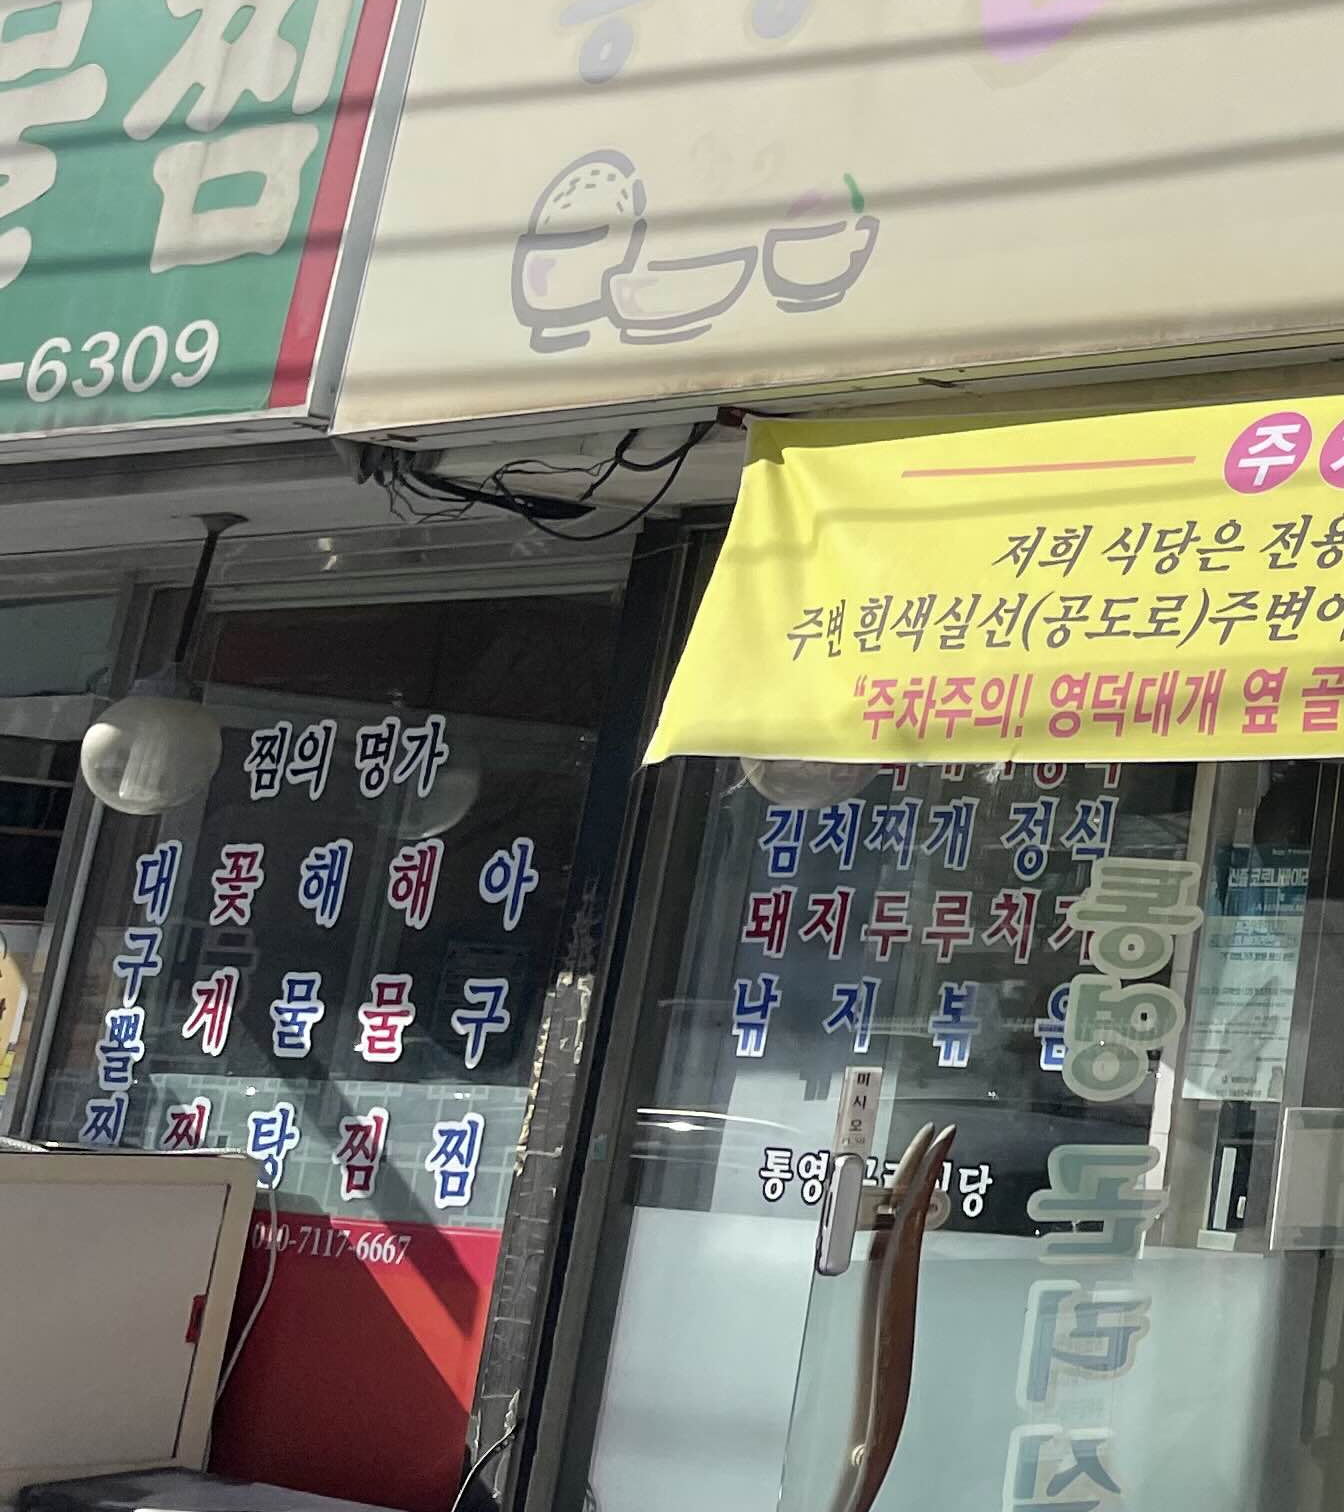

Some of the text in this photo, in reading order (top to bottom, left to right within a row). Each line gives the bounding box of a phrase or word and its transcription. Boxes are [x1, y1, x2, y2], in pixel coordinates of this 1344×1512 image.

[991, 524, 1093, 578] 저희
[1101, 519, 1245, 575] 식당은
[786, 598, 846, 661] 주변
[1047, 667, 1228, 738] 영덕대개
[1242, 665, 1288, 735] 옆
[243, 714, 448, 801] 찜의 명가
[759, 795, 1119, 881] 김치찌개 정식
[336, 838, 444, 1200] 해물찜
[427, 837, 539, 1208] 아구찜
[758, 1146, 831, 1206] 통영
